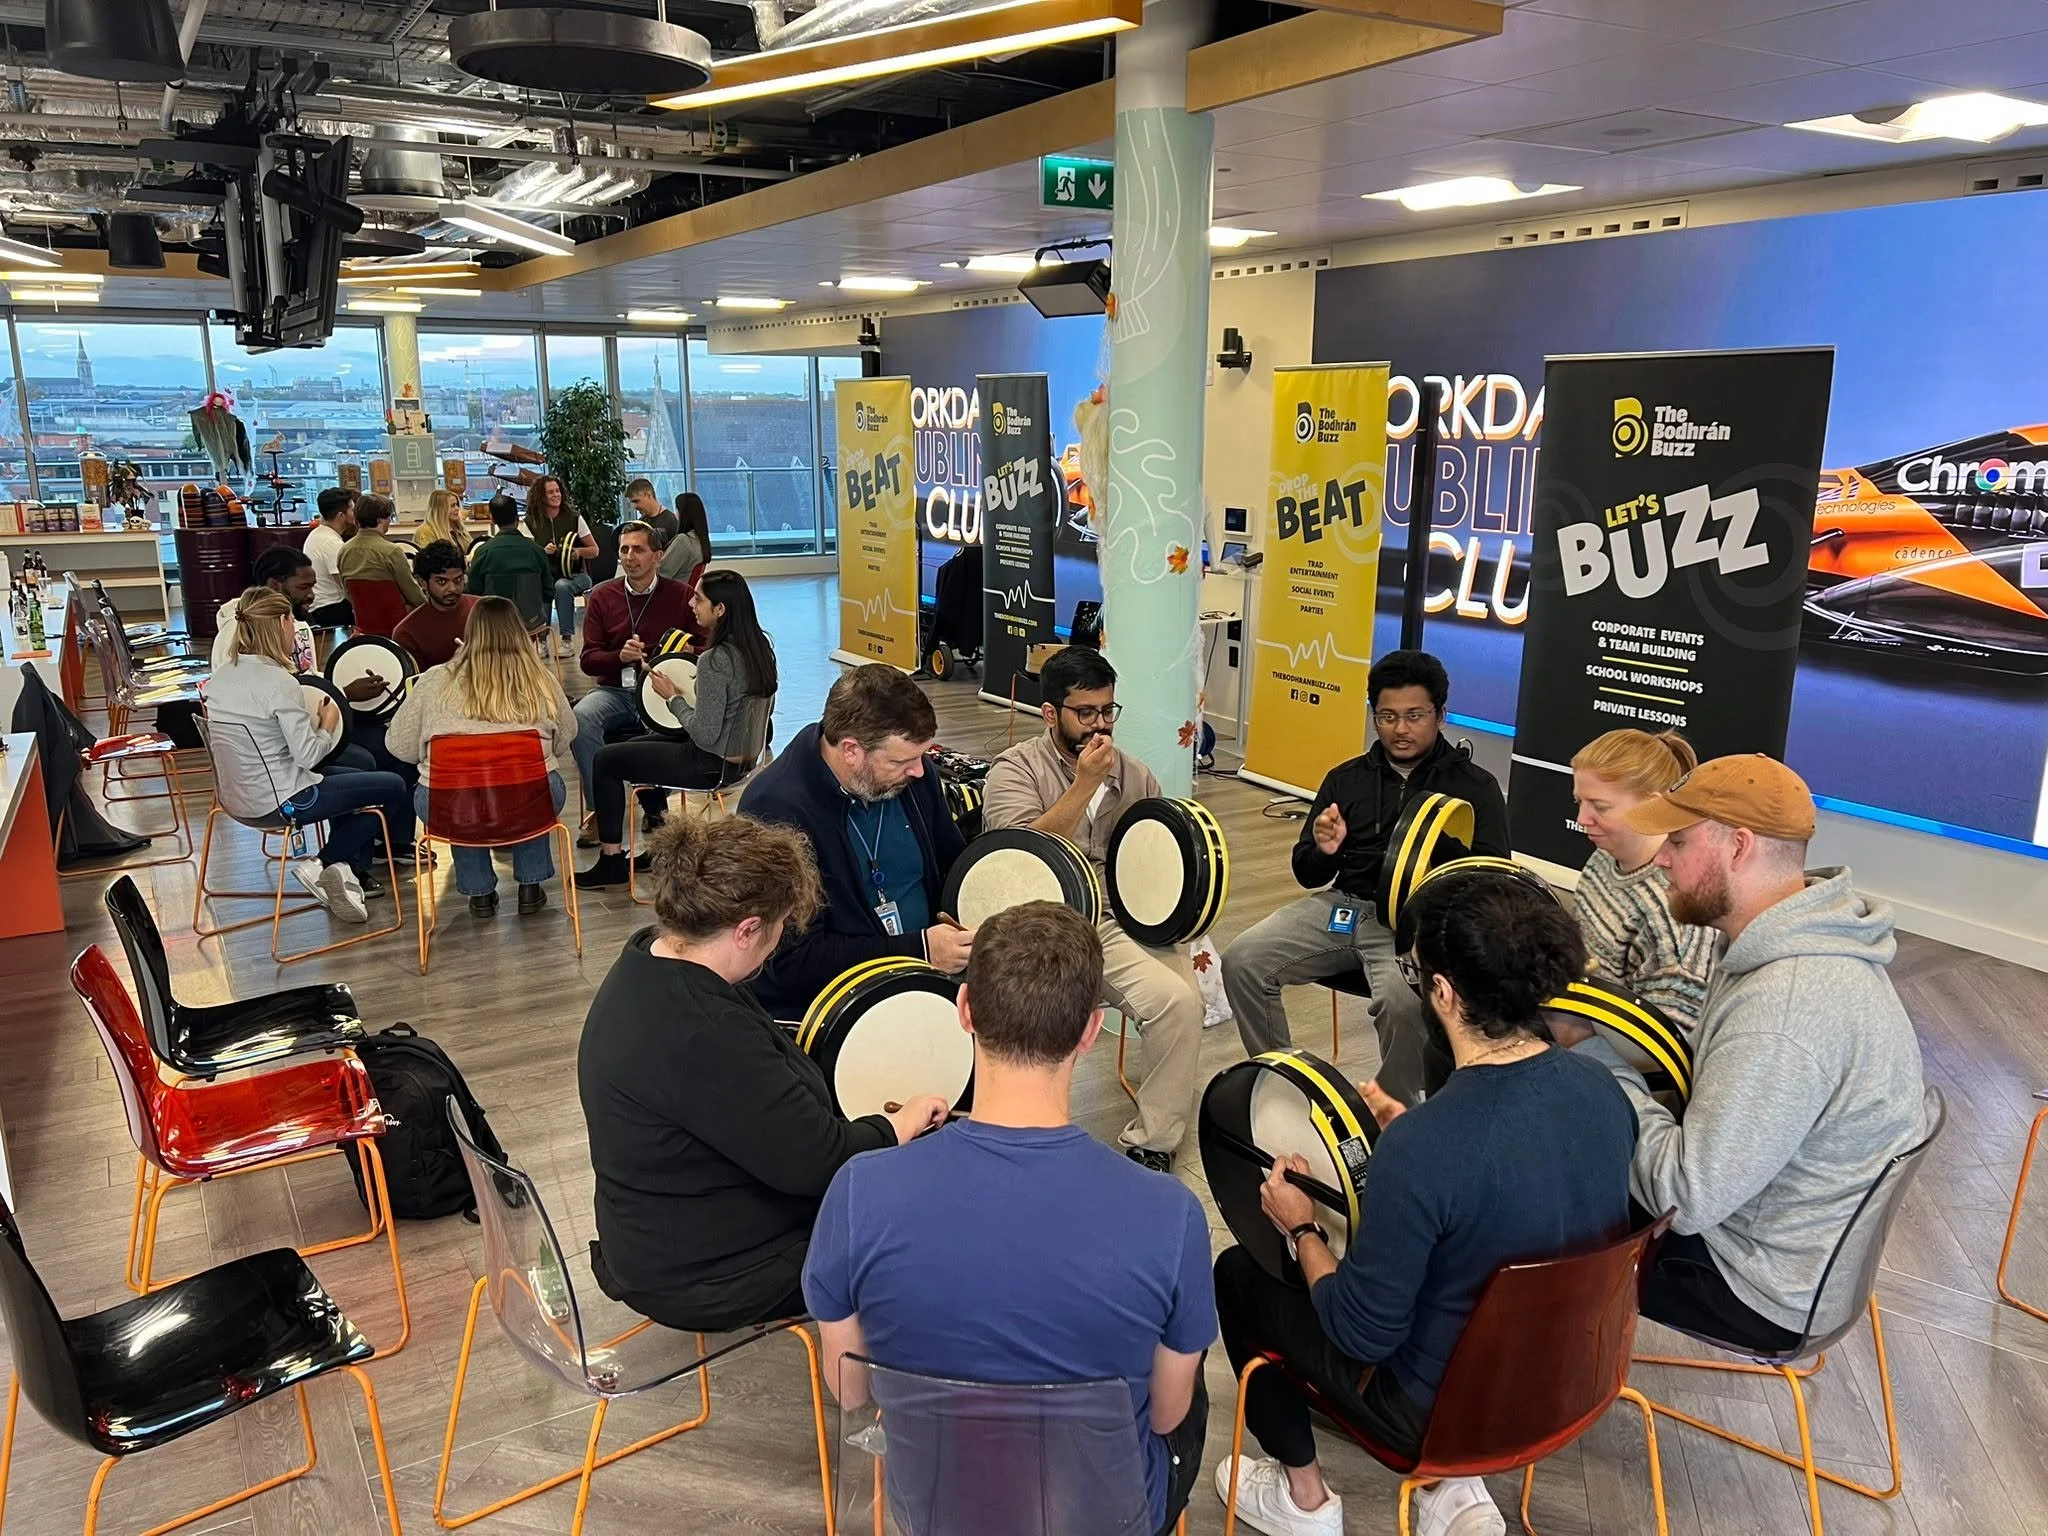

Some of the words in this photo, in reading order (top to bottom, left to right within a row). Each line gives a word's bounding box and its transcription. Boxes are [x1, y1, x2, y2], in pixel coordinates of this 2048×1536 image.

[911, 387, 980, 429] ORKDA
[1006, 407, 1017, 416] The
[1319, 408, 1335, 418] The
[1655, 406, 1688, 422] The
[1007, 427, 1021, 435] Buzz
[1318, 419, 1356, 431] Bodhrán
[1653, 422, 1731, 440] Bodhrán
[1317, 432, 1339, 442] Buzz
[1651, 440, 1695, 457] Buzz
[845, 452, 900, 512] BEAT
[984, 456, 1044, 511] BUZZ
[1383, 444, 1541, 535] UBLI
[1297, 483, 1318, 500] THE
[926, 486, 984, 544] CLU
[1276, 479, 1366, 544] BEAT
[1605, 494, 1660, 528] LET'S
[1816, 500, 1896, 514] echnologies
[1556, 484, 1770, 599] BUZZ
[1308, 560, 1324, 569] TRAD
[1290, 567, 1338, 580] ENTERTAINMENT
[1291, 585, 1312, 596] SOCIAL
[1313, 588, 1334, 598] EVENTS
[1300, 605, 1324, 615] PARTIES
[1591, 620, 1656, 639] CORPORATE
[1660, 629, 1704, 646] EVENTS
[1598, 637, 1607, 647] &
[1608, 638, 1640, 653] TEAM
[1641, 643, 1696, 661] BUILDING
[1272, 671, 1341, 693] THEBODHRANBUZZ.COM
[1585, 665, 1628, 681] SCHOOL
[1630, 671, 1703, 694] WORKSHOPS
[1593, 700, 1636, 717] PRIVATE
[1637, 708, 1687, 727] LESSONS
[1565, 819, 1588, 833] THE
